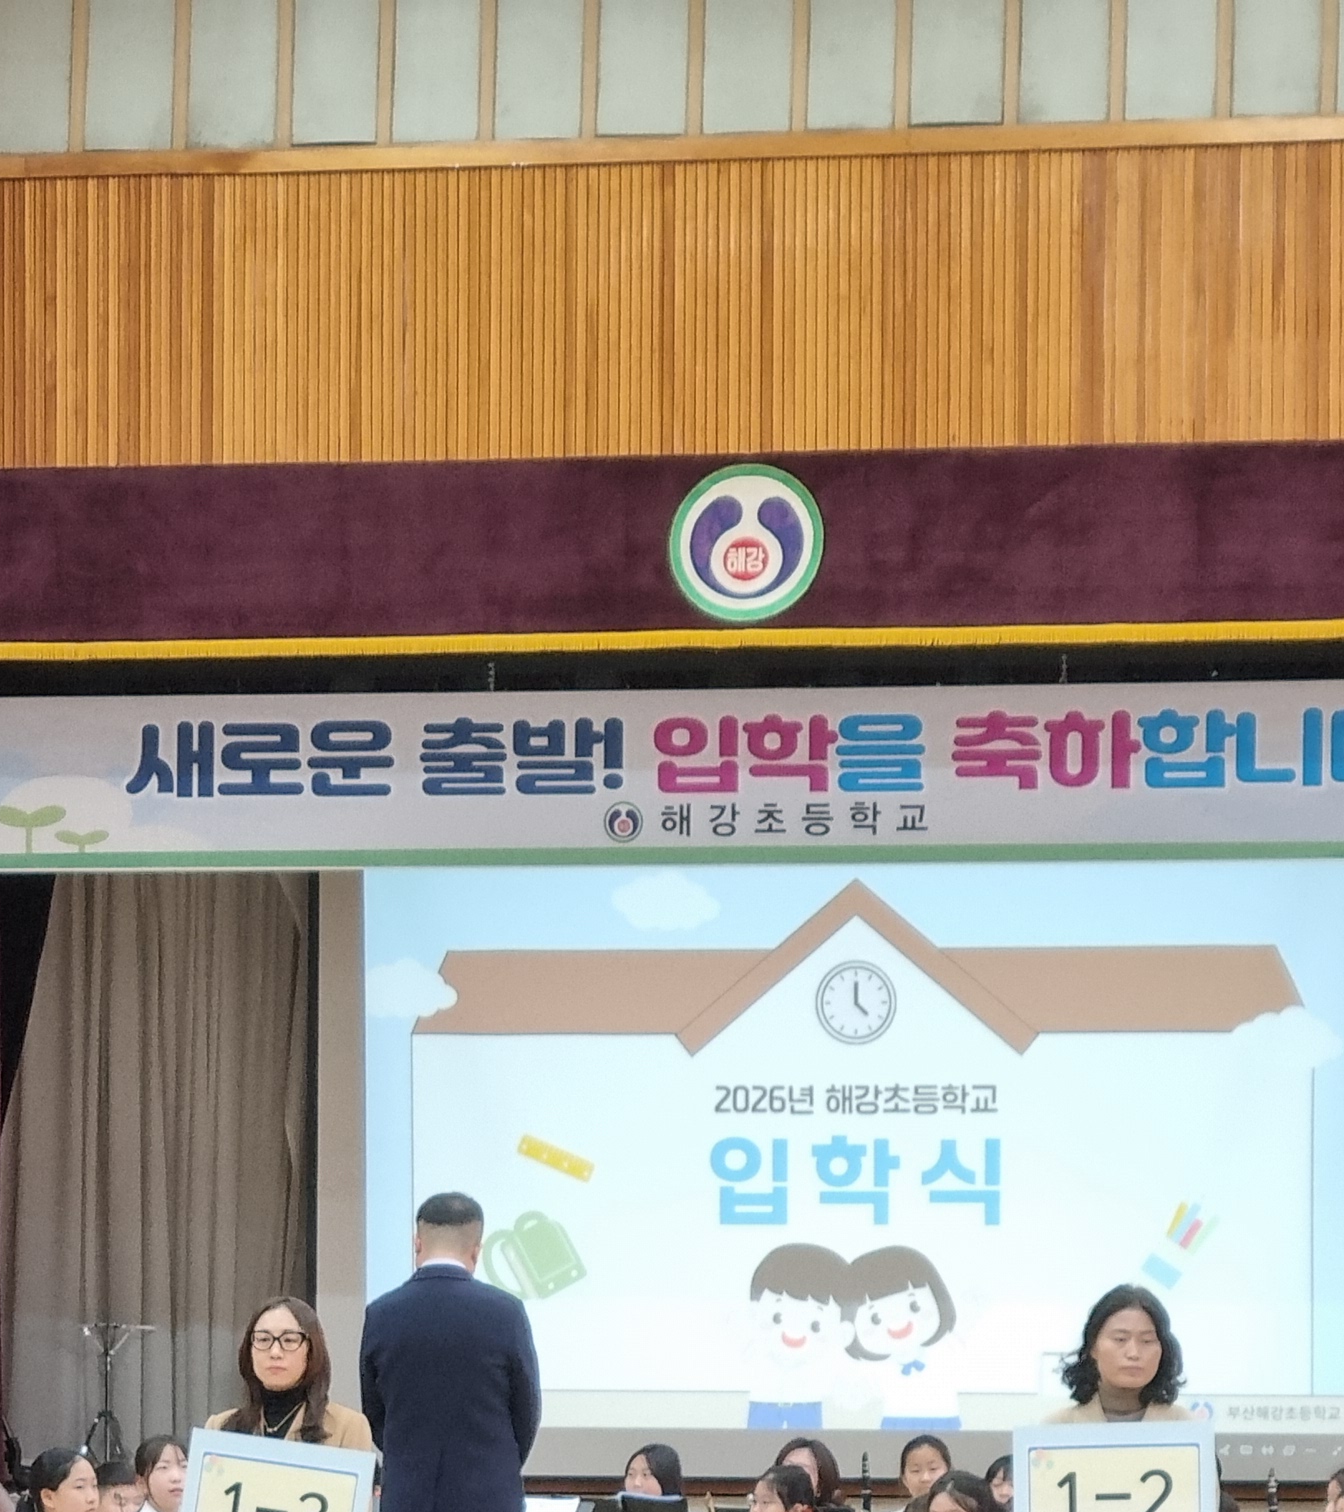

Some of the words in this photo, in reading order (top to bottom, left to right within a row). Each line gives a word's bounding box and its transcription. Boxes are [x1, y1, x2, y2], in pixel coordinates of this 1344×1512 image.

[726, 547, 765, 573] 해강
[125, 720, 394, 797] 새로운
[419, 717, 624, 795] 출발!
[653, 713, 925, 793] 입학을
[660, 801, 929, 837] 해강초등학교
[714, 1084, 814, 1115] 2026년
[825, 1083, 998, 1115] 해강초등학교
[709, 1135, 1001, 1226] 입학식
[1227, 1405, 1341, 1421] 부산해강초등학교
